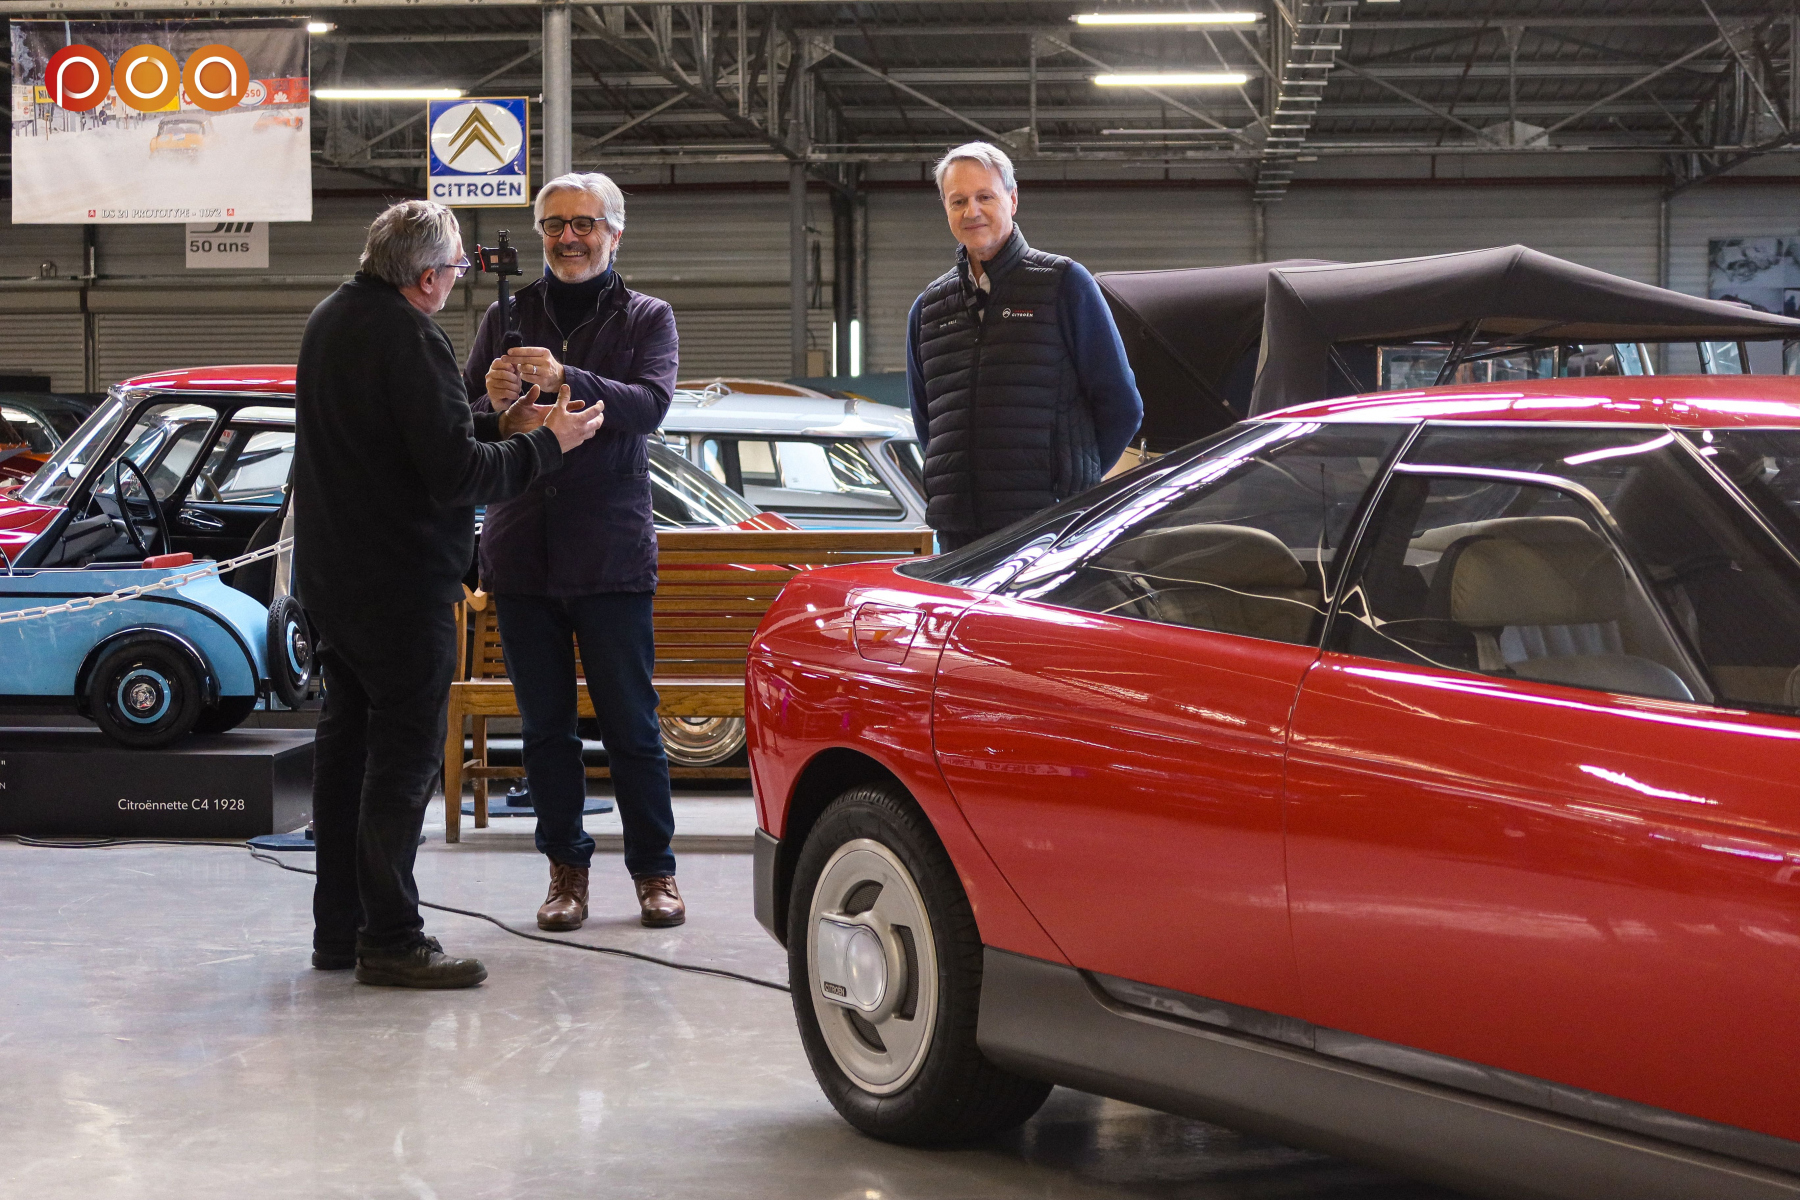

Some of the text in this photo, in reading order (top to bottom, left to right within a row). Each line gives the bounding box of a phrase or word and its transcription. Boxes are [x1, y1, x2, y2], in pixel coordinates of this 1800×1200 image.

[433, 180, 522, 197] CITROËN
[101, 209, 116, 219] DS
[132, 209, 190, 218] PROTOTYPE
[190, 240, 250, 253] 50 ans
[117, 799, 245, 811] Citroënnette C4 1928
